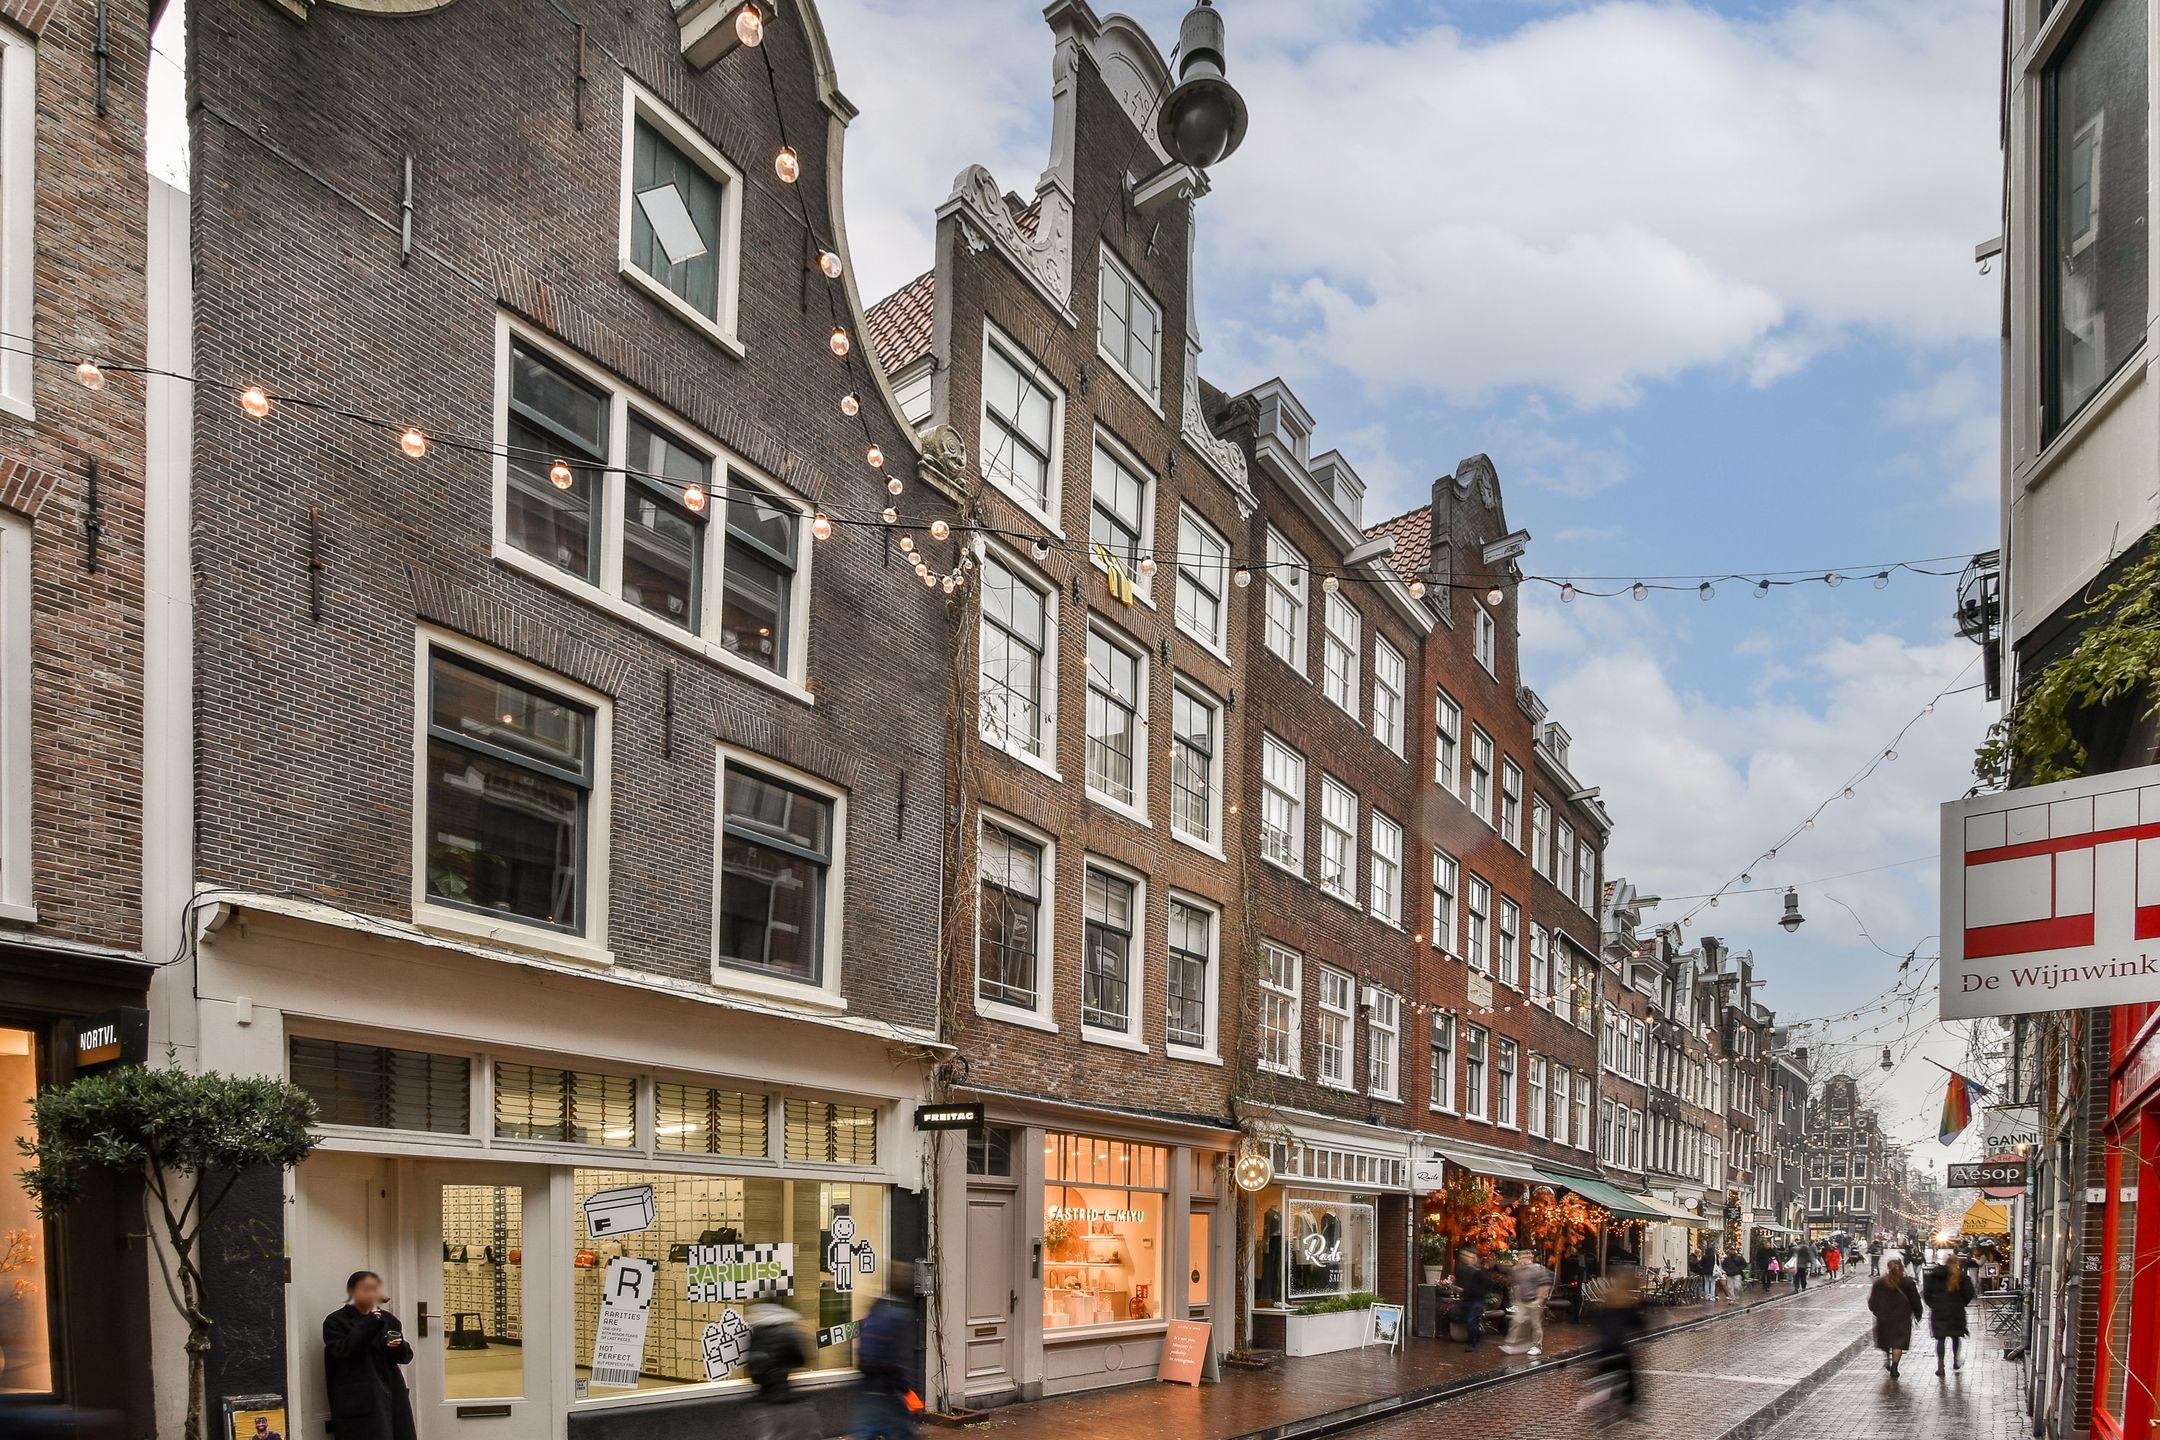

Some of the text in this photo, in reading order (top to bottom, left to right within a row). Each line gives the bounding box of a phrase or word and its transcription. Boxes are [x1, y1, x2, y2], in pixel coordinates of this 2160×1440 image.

[1961, 974, 2000, 993] De
[80, 1024, 117, 1051] NORTVI.
[923, 1112, 974, 1122] FREITAG
[1987, 1132, 2037, 1147] GANNI
[1953, 1165, 2020, 1184] Aesop
[1055, 1206, 1145, 1222] ASTRID & MIYU
[1302, 1232, 1343, 1268] Rails
[862, 1255, 872, 1271] R
[687, 1261, 781, 1285] RARITIES
[1328, 1273, 1344, 1283] SALE
[617, 1266, 643, 1299] R
[687, 1280, 748, 1303] SALE
[603, 1318, 619, 1326] ARE
[604, 1310, 641, 1320] RARITIES
[597, 1353, 632, 1361] PERFECT
